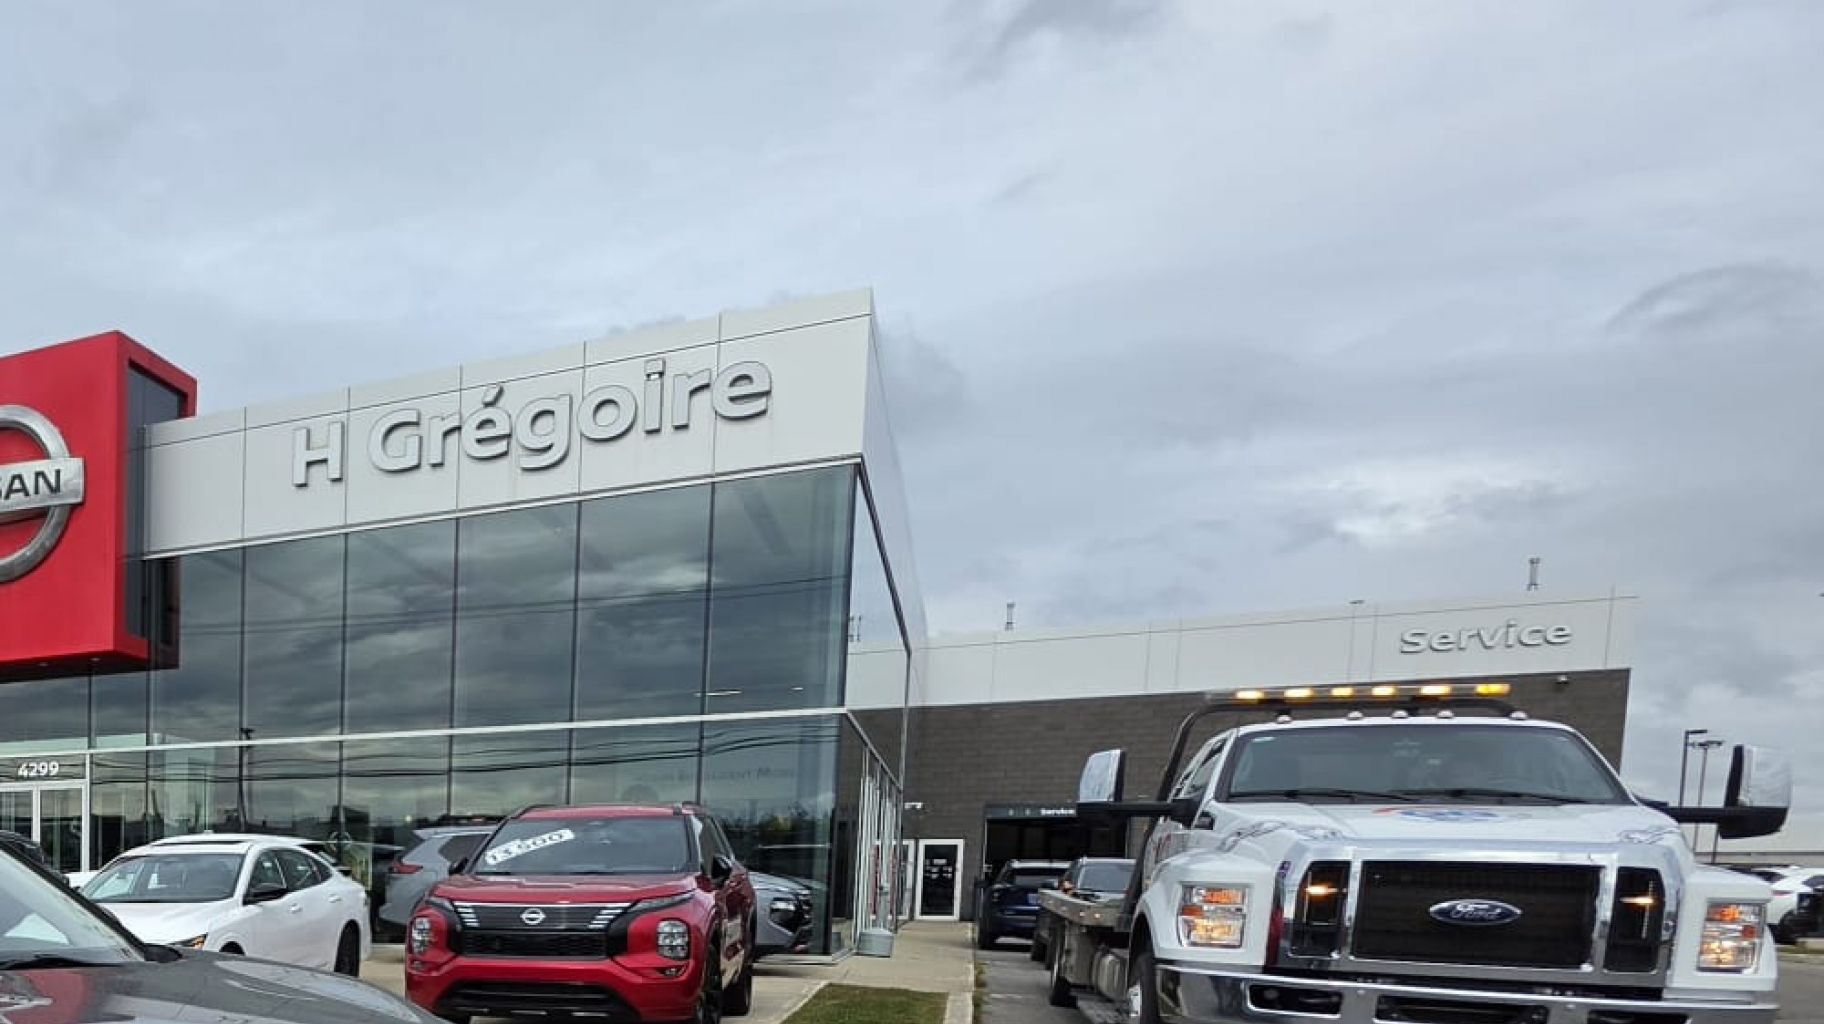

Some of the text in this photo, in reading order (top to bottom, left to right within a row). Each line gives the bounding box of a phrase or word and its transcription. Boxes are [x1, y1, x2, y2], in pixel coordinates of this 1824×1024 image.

[291, 357, 773, 487] H Grégoire
[1401, 618, 1573, 654] Service
[17, 761, 59, 777] 4299
